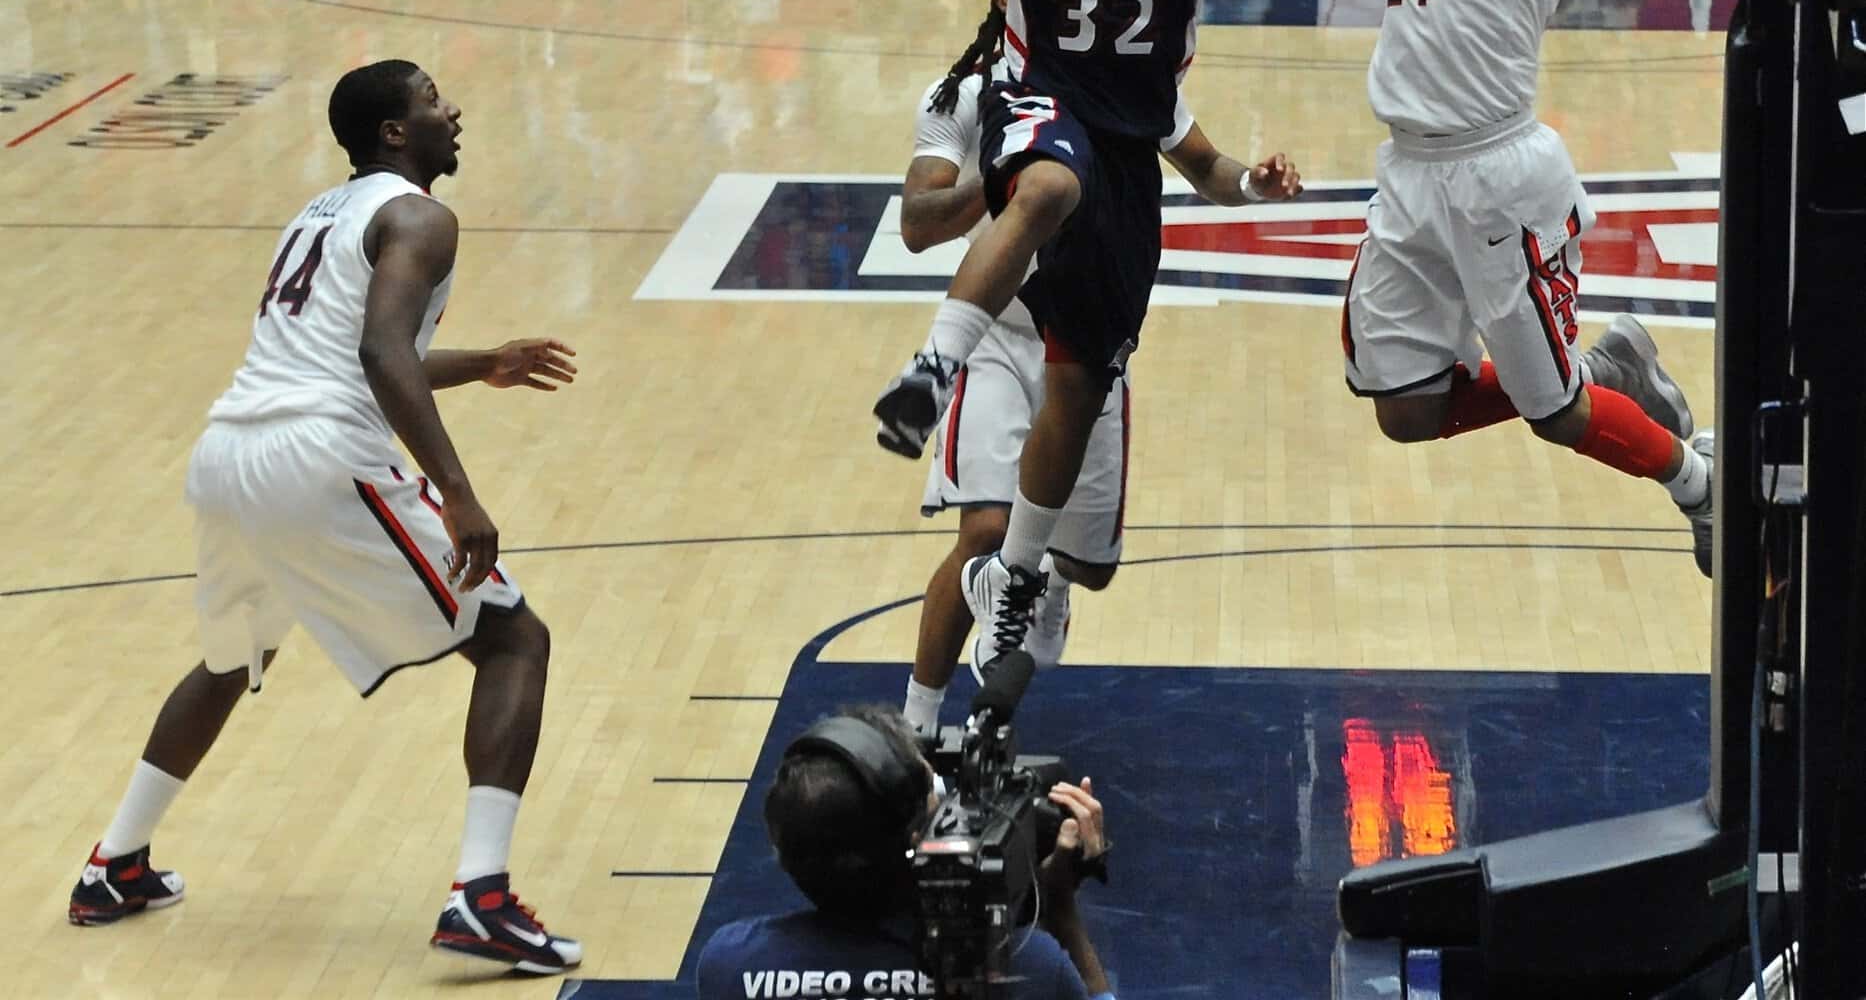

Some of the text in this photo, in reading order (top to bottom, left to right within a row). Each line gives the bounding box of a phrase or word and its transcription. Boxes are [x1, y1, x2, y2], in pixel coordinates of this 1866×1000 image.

[259, 222, 334, 319] 44
[743, 970, 936, 999] VIDEO CRE
